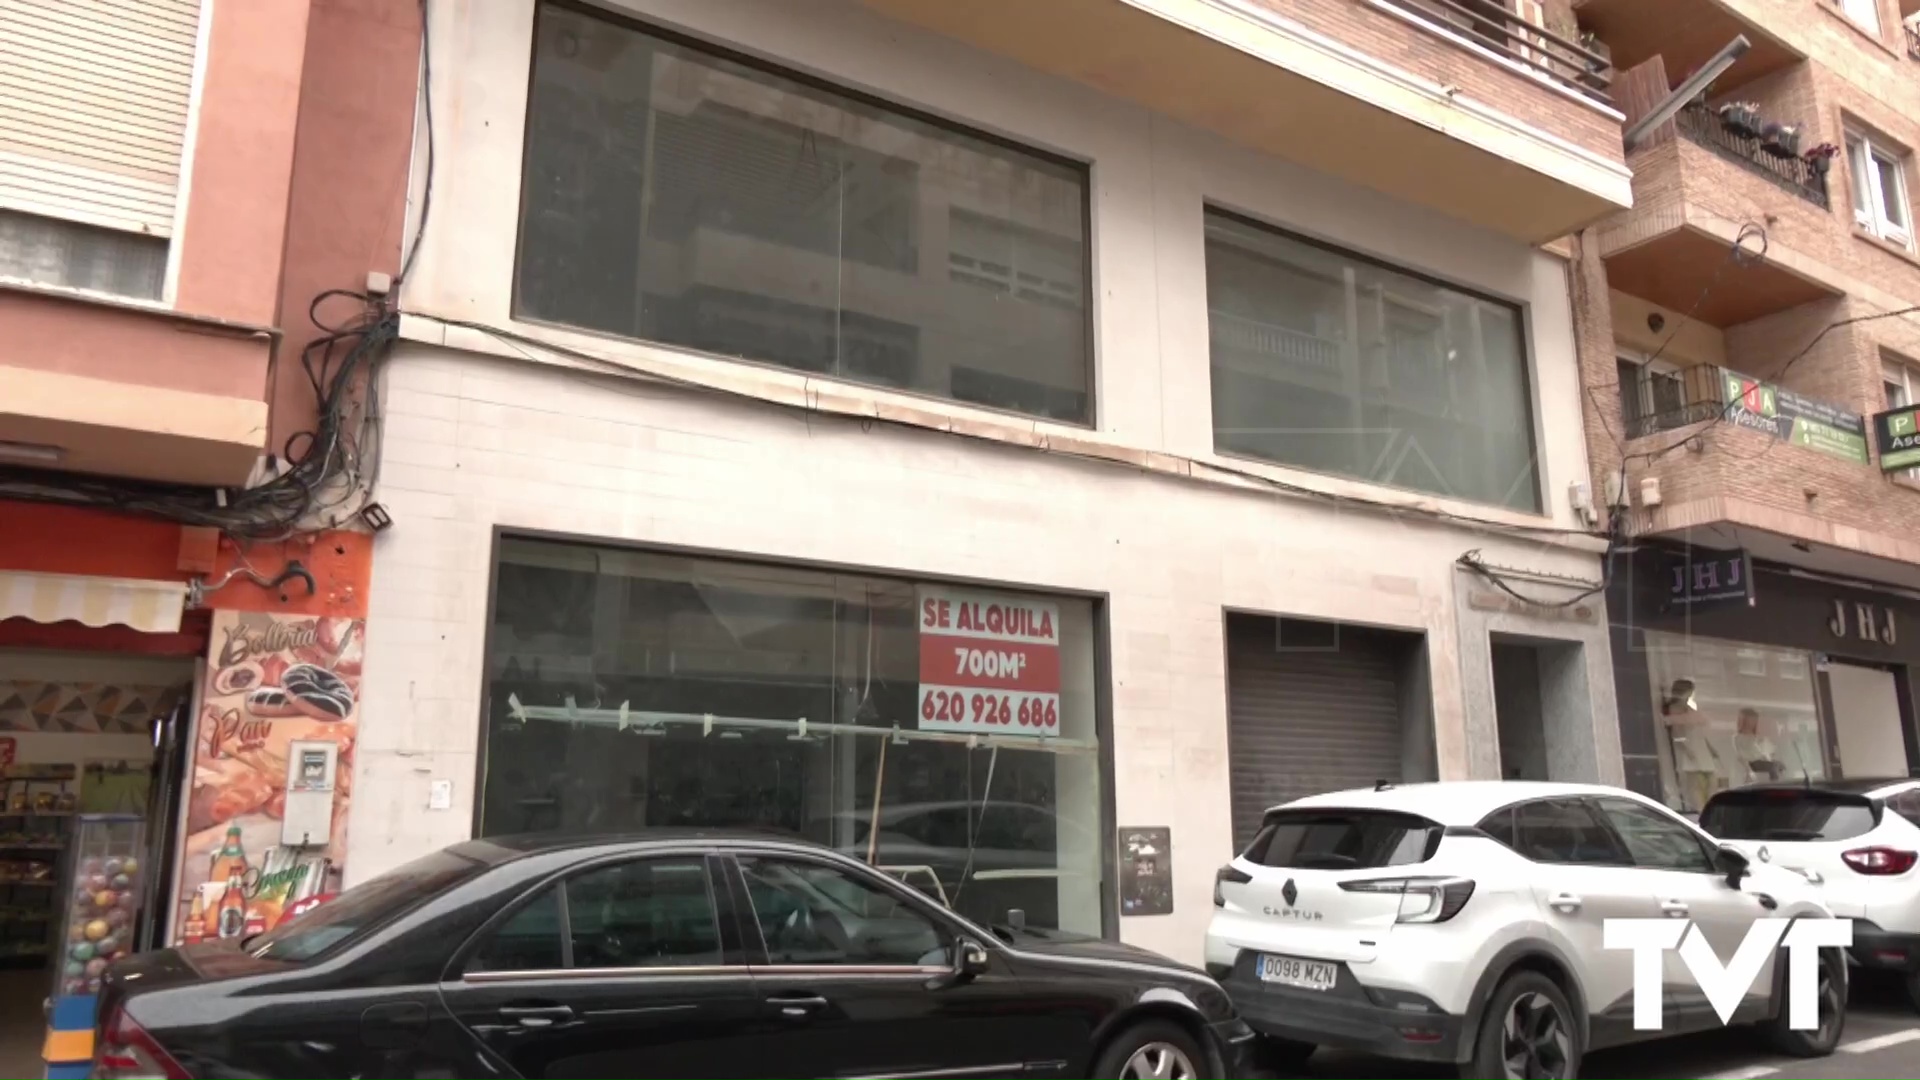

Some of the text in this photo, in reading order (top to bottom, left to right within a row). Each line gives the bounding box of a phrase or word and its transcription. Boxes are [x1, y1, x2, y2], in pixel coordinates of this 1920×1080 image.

[923, 598, 1053, 638] SE ALQUILA
[922, 690, 1056, 727] 620 926 686
[208, 708, 272, 758] Pan
[1263, 906, 1324, 920] CAPTUR
[1266, 958, 1333, 985] 0098 MZN
